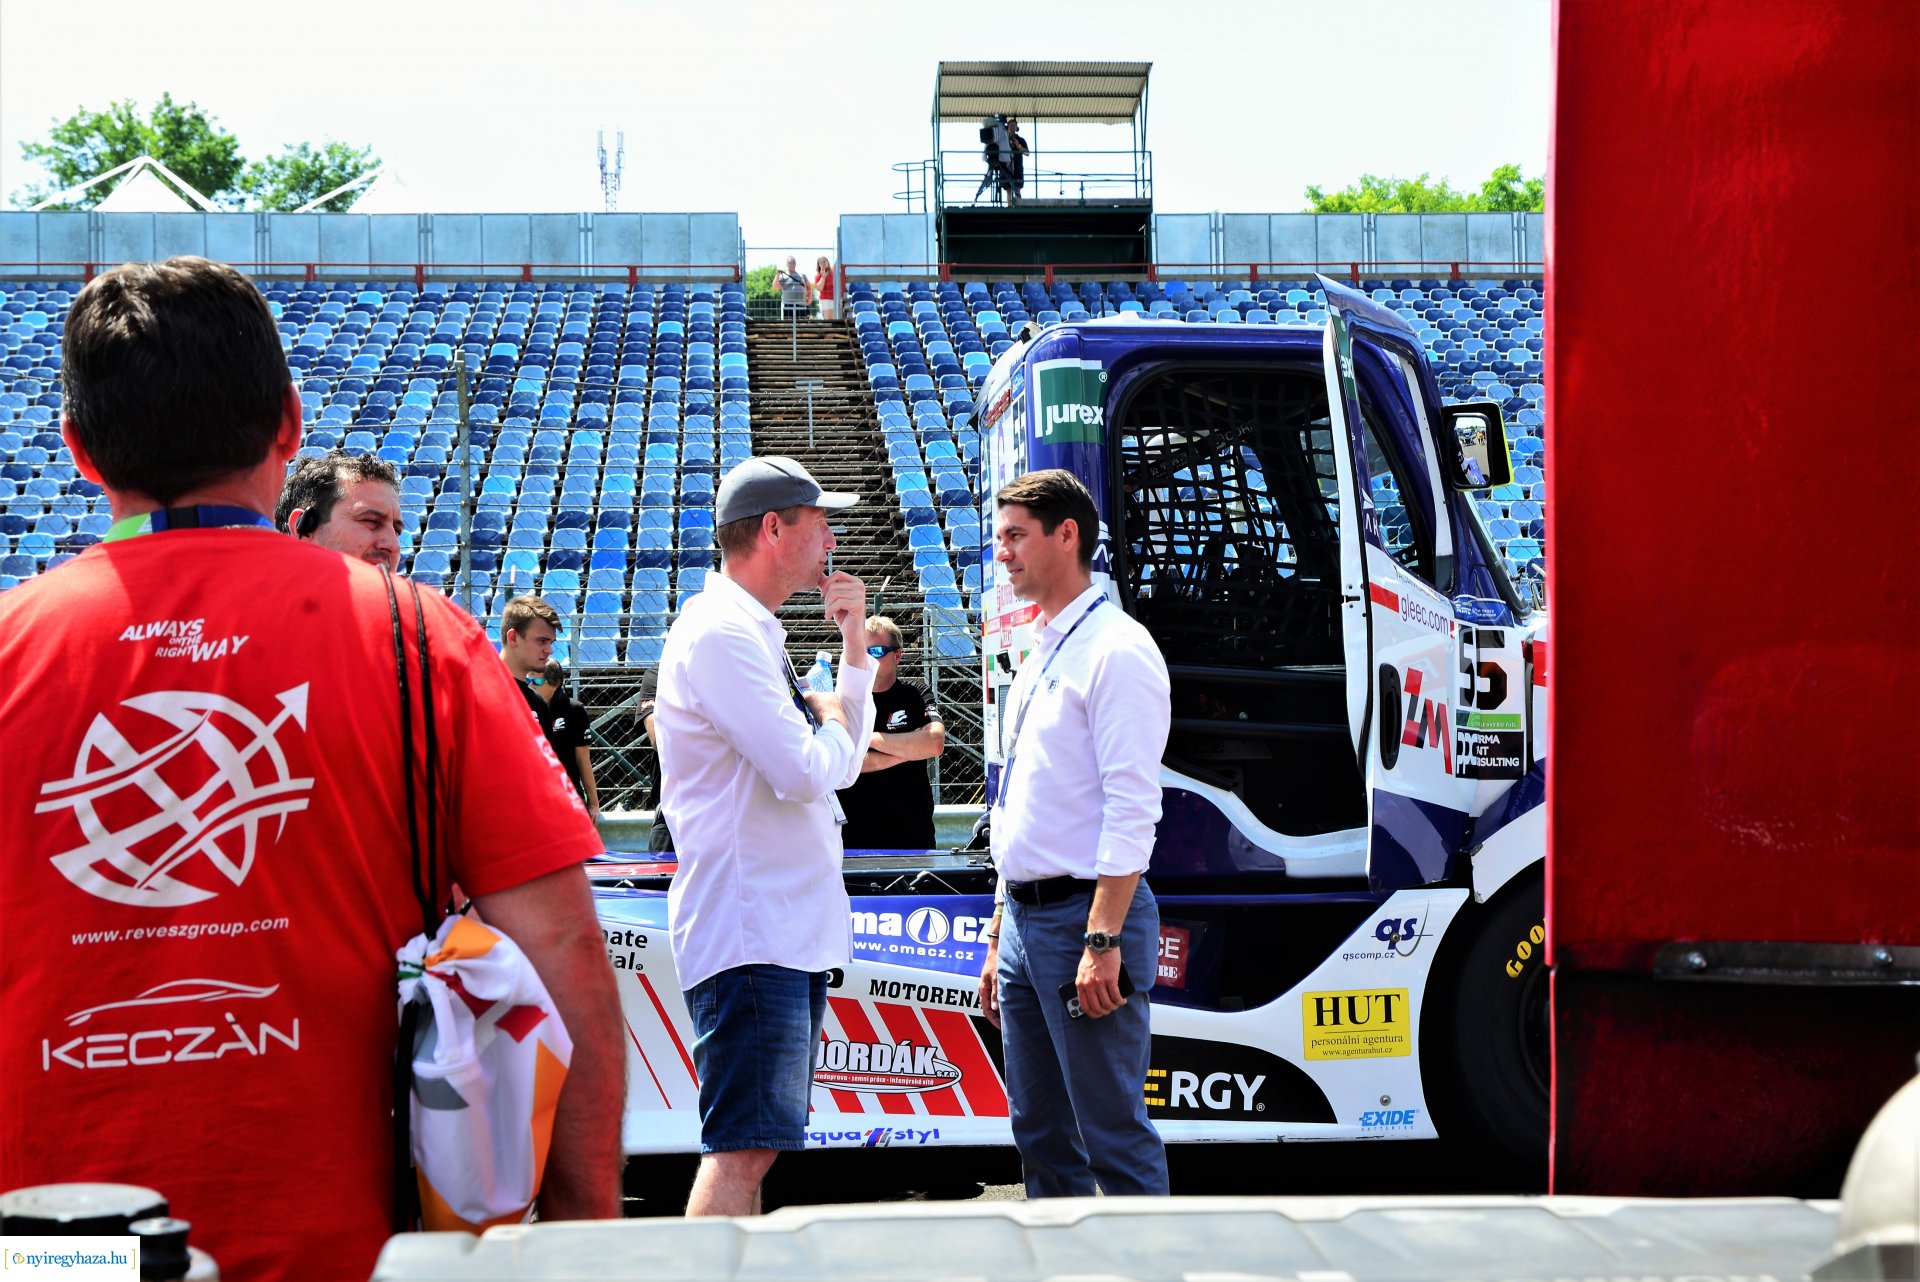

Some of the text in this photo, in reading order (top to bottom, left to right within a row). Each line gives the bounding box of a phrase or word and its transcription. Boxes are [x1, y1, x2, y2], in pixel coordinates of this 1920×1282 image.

[1045, 403, 1104, 436] jurex
[1401, 594, 1449, 636] gleec.com
[119, 618, 205, 641] ALWAYS
[155, 635, 249, 662] RIGHT WAY
[71, 917, 290, 945] www.reveszgroup.com
[1375, 918, 1418, 950] qs
[1342, 952, 1395, 961] qscomp.cz
[1506, 917, 1546, 978] GOO
[1312, 994, 1401, 1026] HUT
[1311, 1034, 1403, 1048] personální agentura
[1322, 1047, 1393, 1056] www.agenturahut.cz
[869, 1076, 886, 1084] práce
[1144, 1069, 1267, 1111] ERGY
[1360, 1110, 1416, 1126] EXIDE
[894, 1128, 940, 1144] styl
